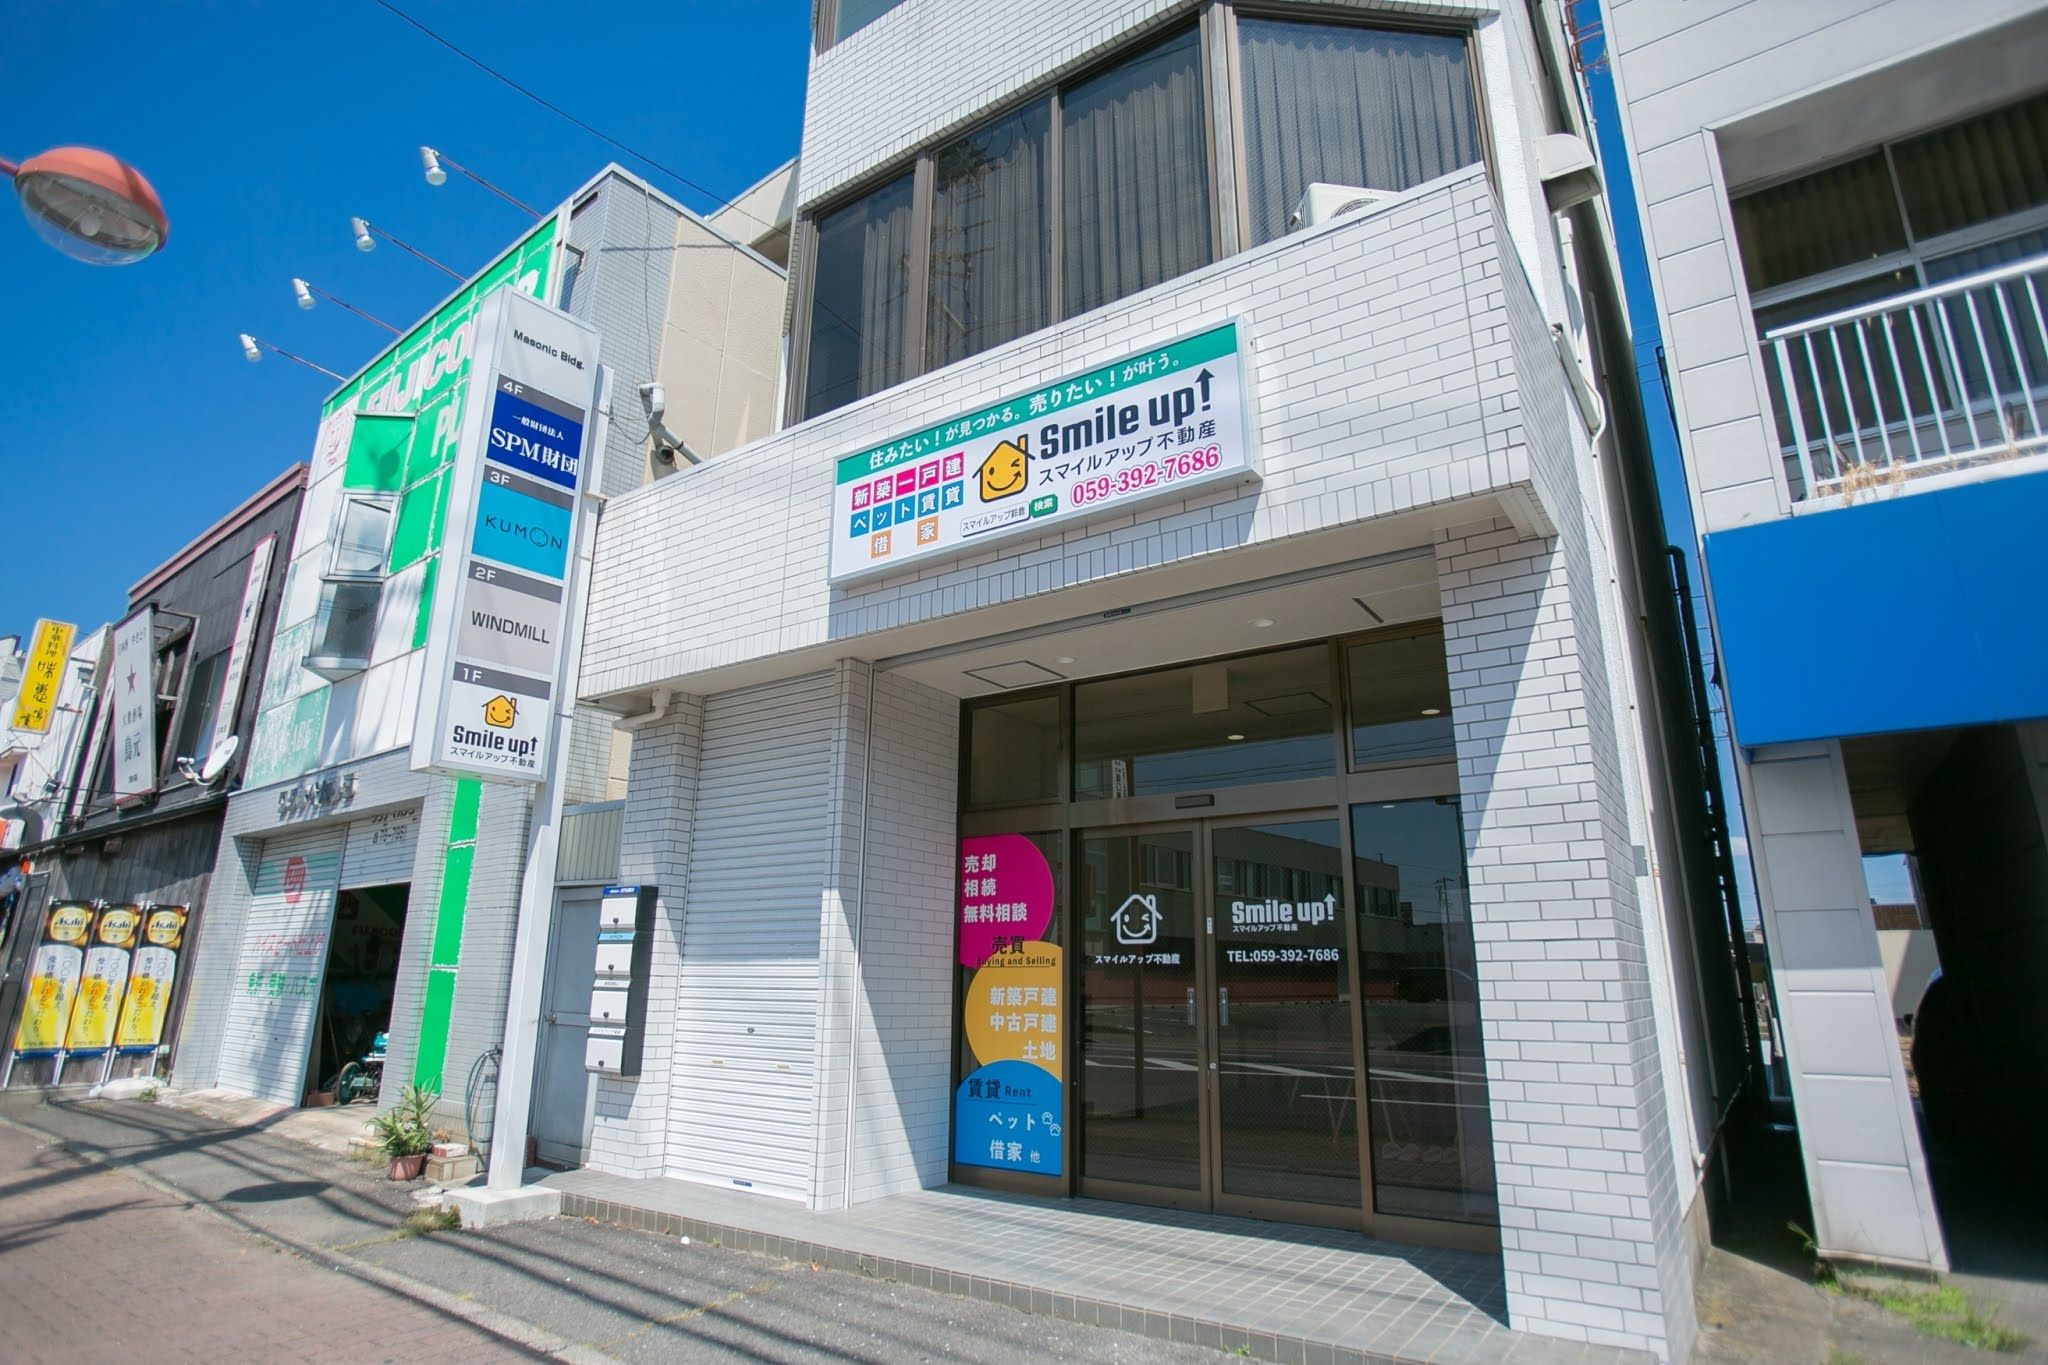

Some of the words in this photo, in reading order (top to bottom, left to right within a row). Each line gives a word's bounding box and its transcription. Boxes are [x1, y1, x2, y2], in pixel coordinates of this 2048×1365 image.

[513, 329, 558, 357] Masonic
[503, 381, 523, 395] 4F
[512, 414, 564, 441] 一般財団法人
[1040, 402, 1139, 460] Smile
[491, 427, 578, 476] SPM財団
[1039, 419, 1217, 486] スマイルアップ不動産
[490, 471, 510, 485] 3F
[1071, 444, 1222, 507] 059-392-7686
[852, 482, 963, 534] ペット賃貸
[962, 504, 1026, 532] スマイルアップ鈴鹿
[1033, 498, 1055, 514] 検索
[485, 515, 563, 550] KUMON
[475, 566, 496, 581] 2F
[471, 610, 550, 645] WINDMILL
[463, 667, 482, 682] 1F
[453, 725, 504, 751] Smile
[449, 746, 536, 769] スマイルアップ不動産
[964, 853, 996, 873] 売却
[964, 878, 997, 897] 相続
[54, 917, 85, 927] Asahi
[963, 903, 1027, 923] 無料相談
[1231, 900, 1293, 924] Smile
[103, 918, 132, 929] Asahi
[151, 919, 178, 930] Asahi
[1232, 924, 1299, 933] スマイルアップ不動産
[991, 936, 1025, 955] 売買
[1227, 948, 1340, 963] TEL:059-392-7686
[976, 956, 1005, 968] Buying
[1007, 956, 1023, 966] and
[1026, 956, 1056, 968] Selling
[1094, 953, 1181, 965] スマイルアップ不動産
[989, 986, 1057, 1006] 新築戸建
[989, 1012, 1057, 1033] 中古戸建
[1022, 1040, 1056, 1061] 土地
[968, 1078, 1001, 1099] 賃貸
[1004, 1085, 1032, 1098] Rent
[988, 1113, 1036, 1131] ペット
[989, 1139, 1023, 1162] 借家
[1029, 1150, 1041, 1164] 他
